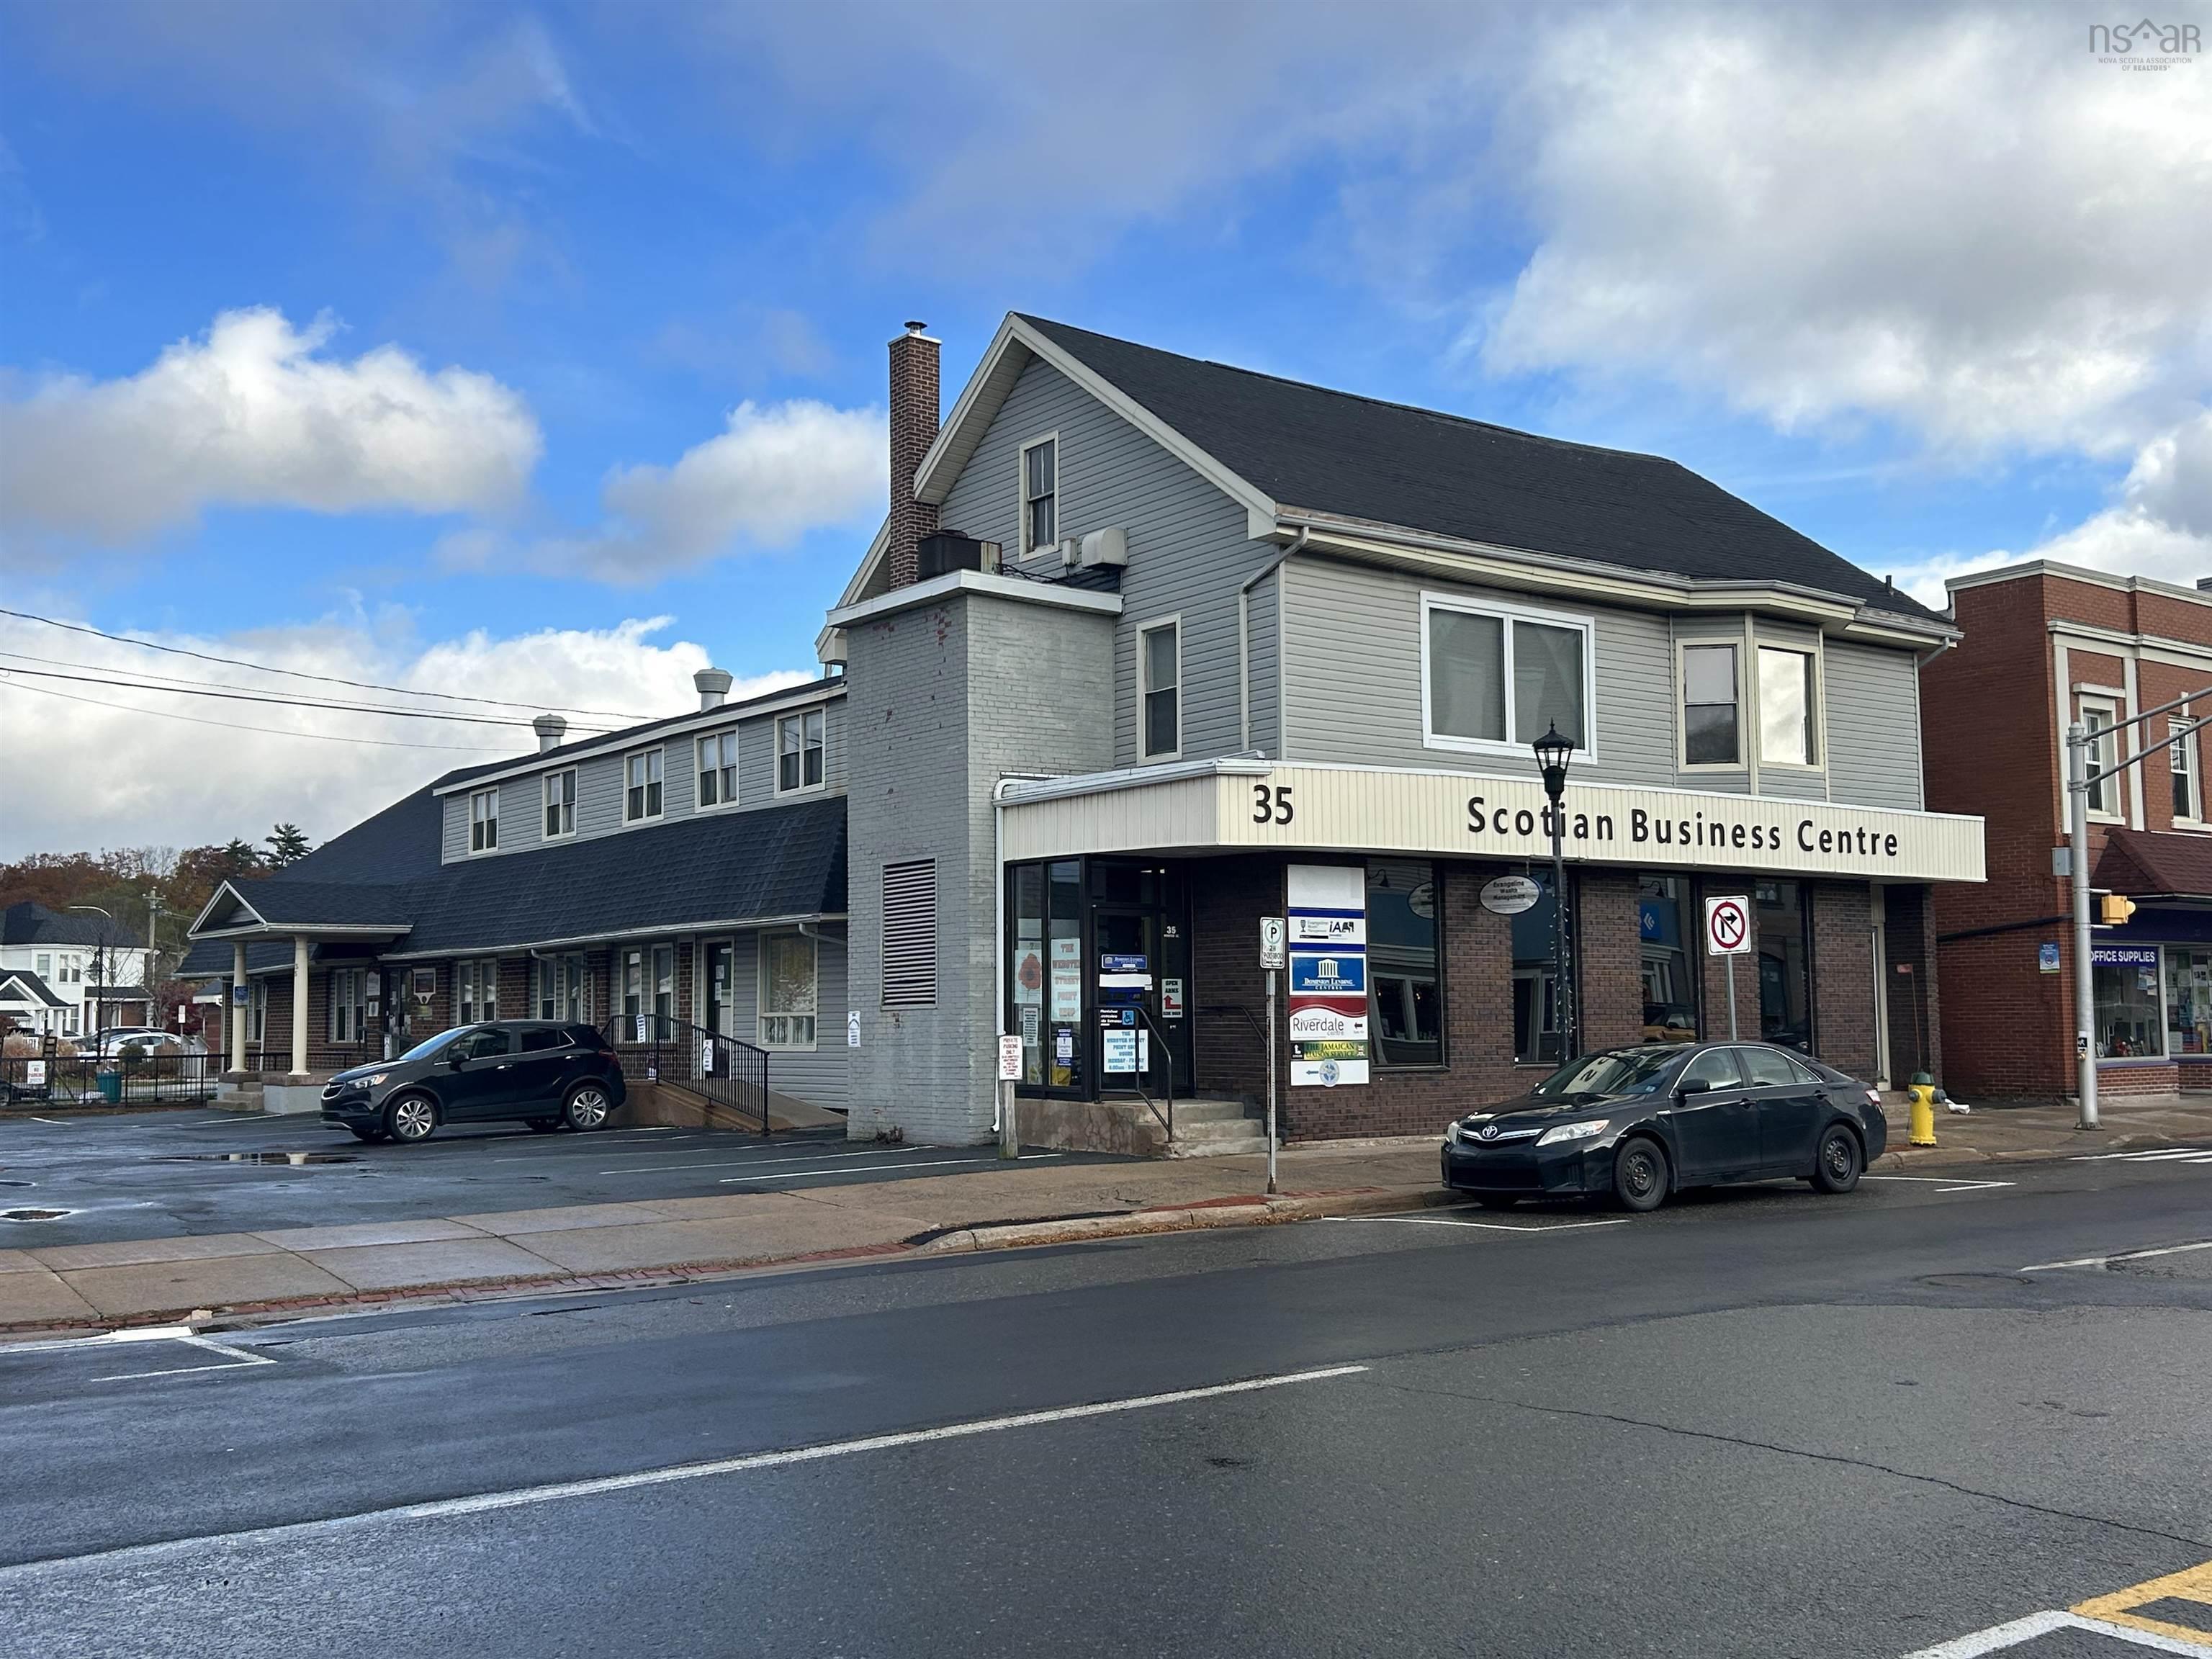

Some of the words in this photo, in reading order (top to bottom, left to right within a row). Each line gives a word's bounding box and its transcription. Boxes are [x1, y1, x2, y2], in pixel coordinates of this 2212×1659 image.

[1253, 784, 1293, 825] 35
[1468, 797, 1613, 840] Scotian
[1631, 809, 1781, 850] Business
[1797, 820, 1898, 857] Centre
[1271, 927, 1277, 938] P
[2090, 950, 2117, 962] OFFICE
[2118, 950, 2155, 963] SUPPLIES
[1292, 1017, 1344, 1031] Riverdale
[1321, 1043, 1354, 1051] JAMAICAN
